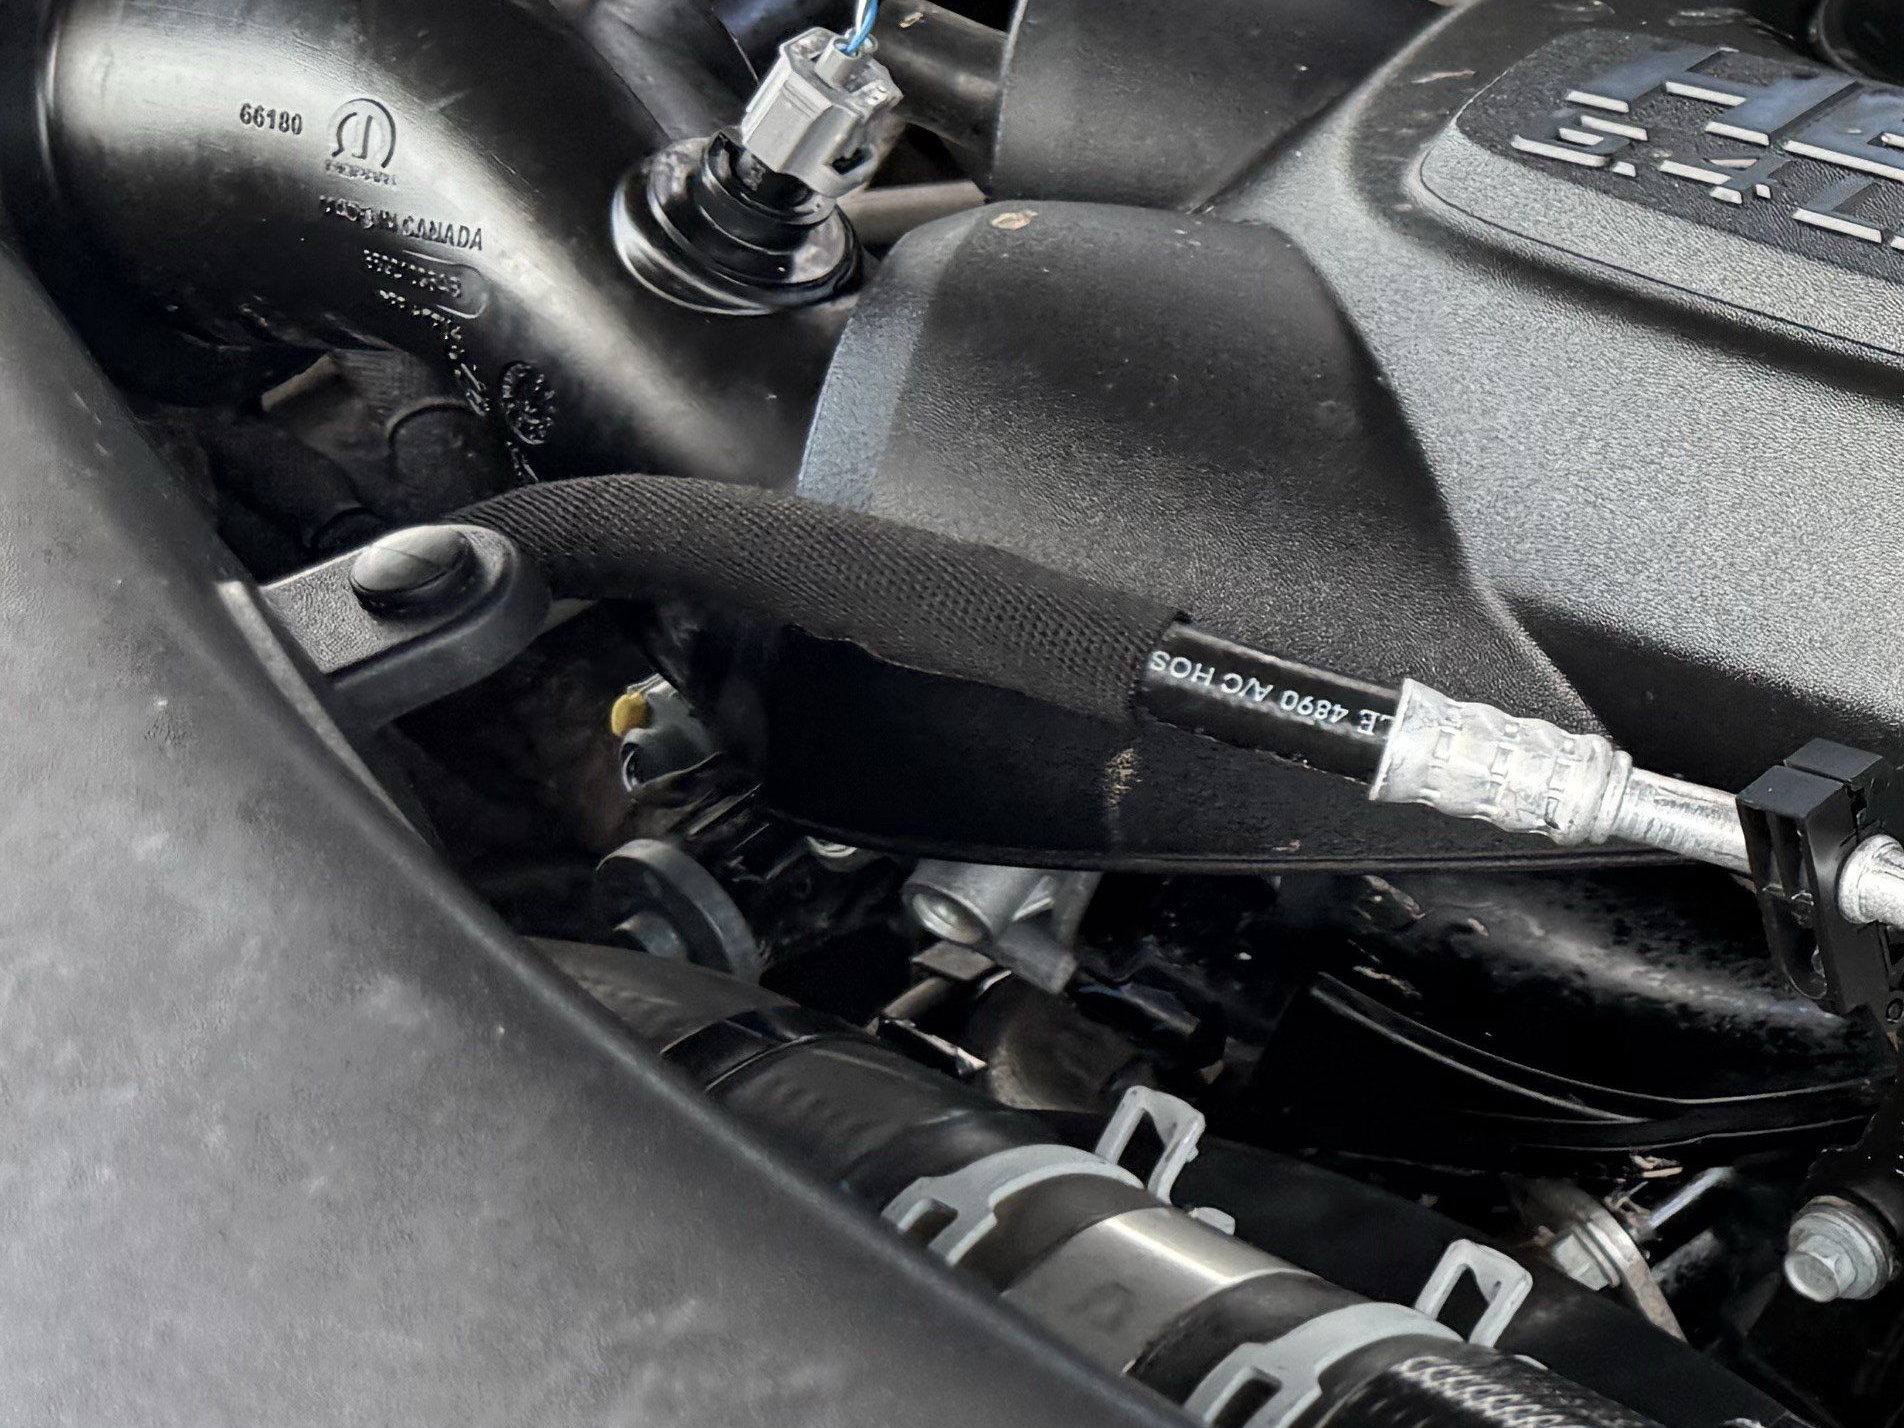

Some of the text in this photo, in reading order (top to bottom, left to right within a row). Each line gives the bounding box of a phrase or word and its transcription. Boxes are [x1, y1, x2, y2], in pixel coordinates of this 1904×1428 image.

[238, 102, 304, 137] 66180
[401, 215, 484, 252] CANADA
[1219, 673, 1275, 703] A/C
[1278, 689, 1350, 725] 4890
